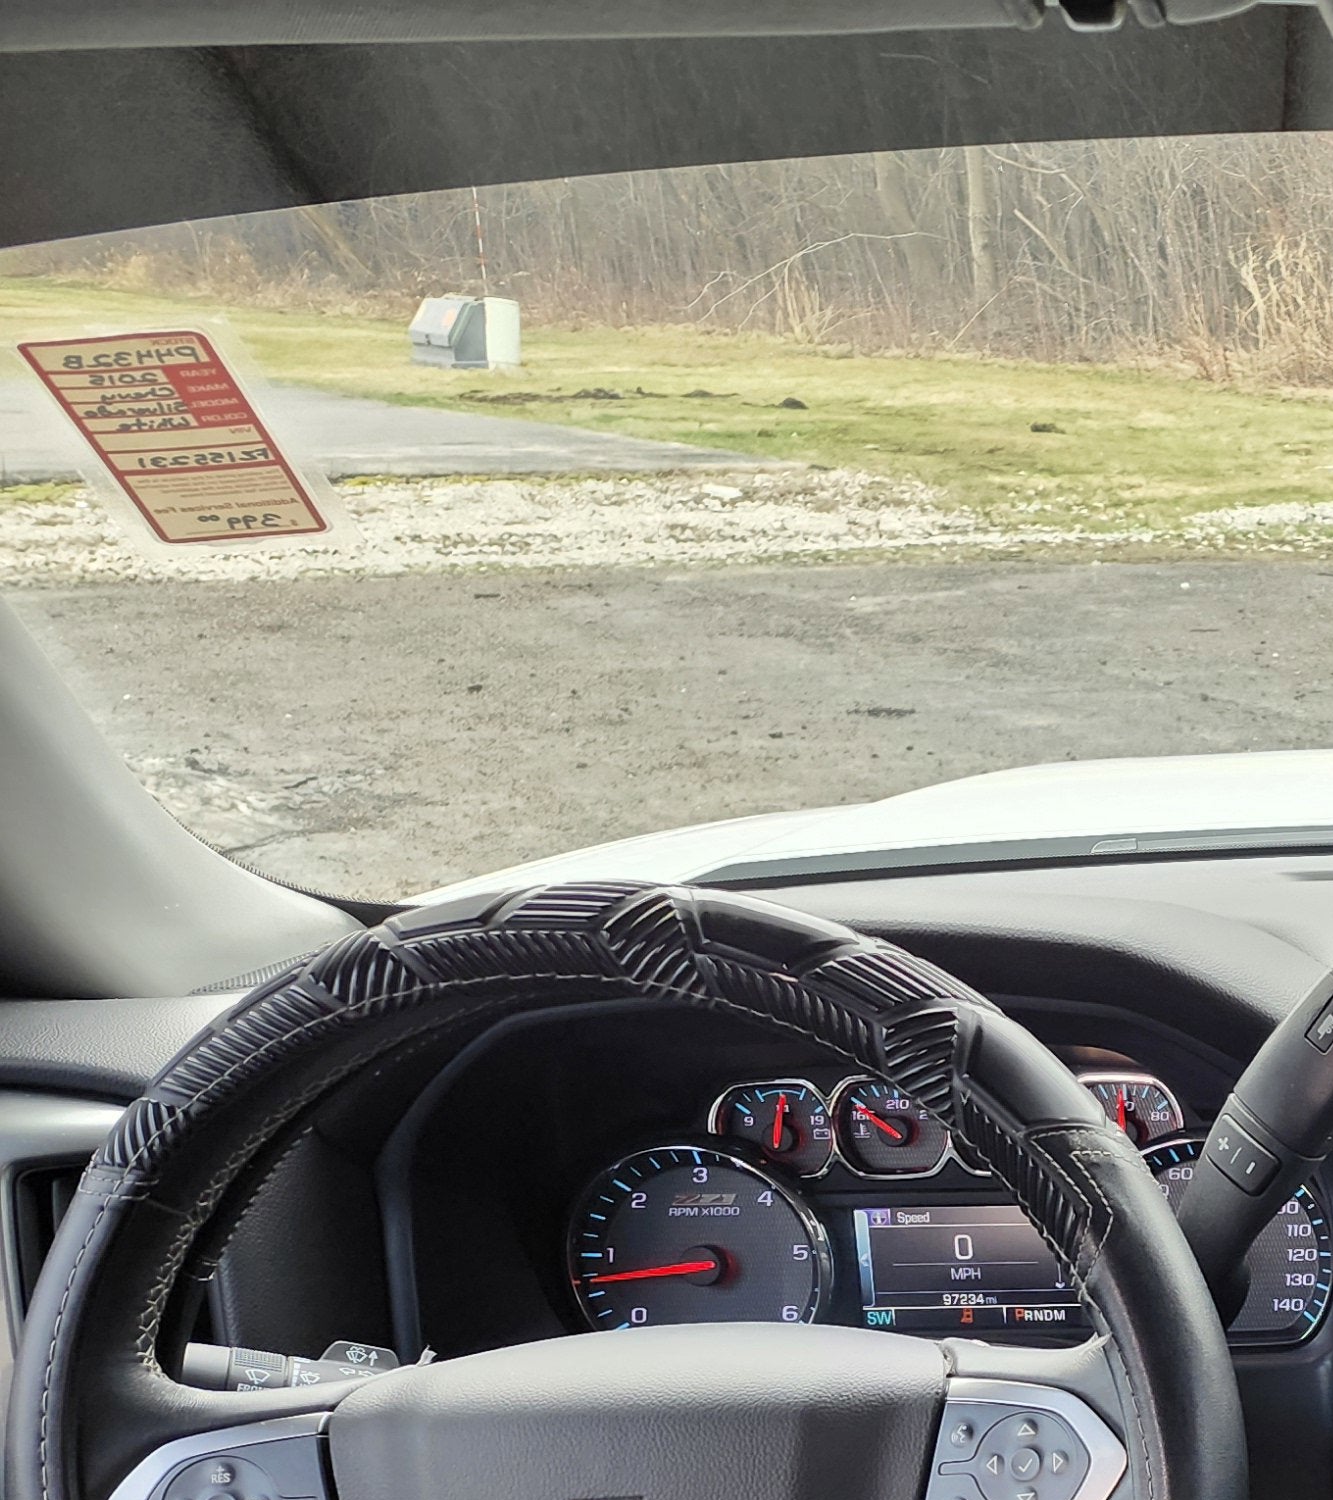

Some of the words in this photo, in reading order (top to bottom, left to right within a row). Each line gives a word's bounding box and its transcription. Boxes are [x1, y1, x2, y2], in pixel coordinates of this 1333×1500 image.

[885, 1099, 910, 1111] 210
[743, 1116, 755, 1127] 9
[809, 1115, 825, 1126] 19
[1150, 1111, 1169, 1122] 80
[692, 1167, 708, 1184] 3
[1168, 1167, 1193, 1181] 60
[630, 1192, 647, 1209] 2
[757, 1190, 774, 1207] 4
[668, 1207, 698, 1217] RPM
[896, 1211, 930, 1225] Speed
[1286, 1224, 1312, 1237] 110
[792, 1244, 809, 1261] 5
[953, 1234, 974, 1260] 0
[606, 1247, 614, 1263] 1
[1287, 1248, 1318, 1262] 120
[950, 1267, 981, 1281] MPH
[1284, 1273, 1315, 1287] 130
[942, 1293, 985, 1305] 97234
[985, 1296, 998, 1305] mi
[1272, 1298, 1304, 1312] 140
[630, 1307, 647, 1324] 0
[781, 1305, 799, 1322] 6
[866, 1311, 892, 1326] SW
[1015, 1308, 1066, 1322] PRNDM
[211, 1472, 231, 1484] RES
